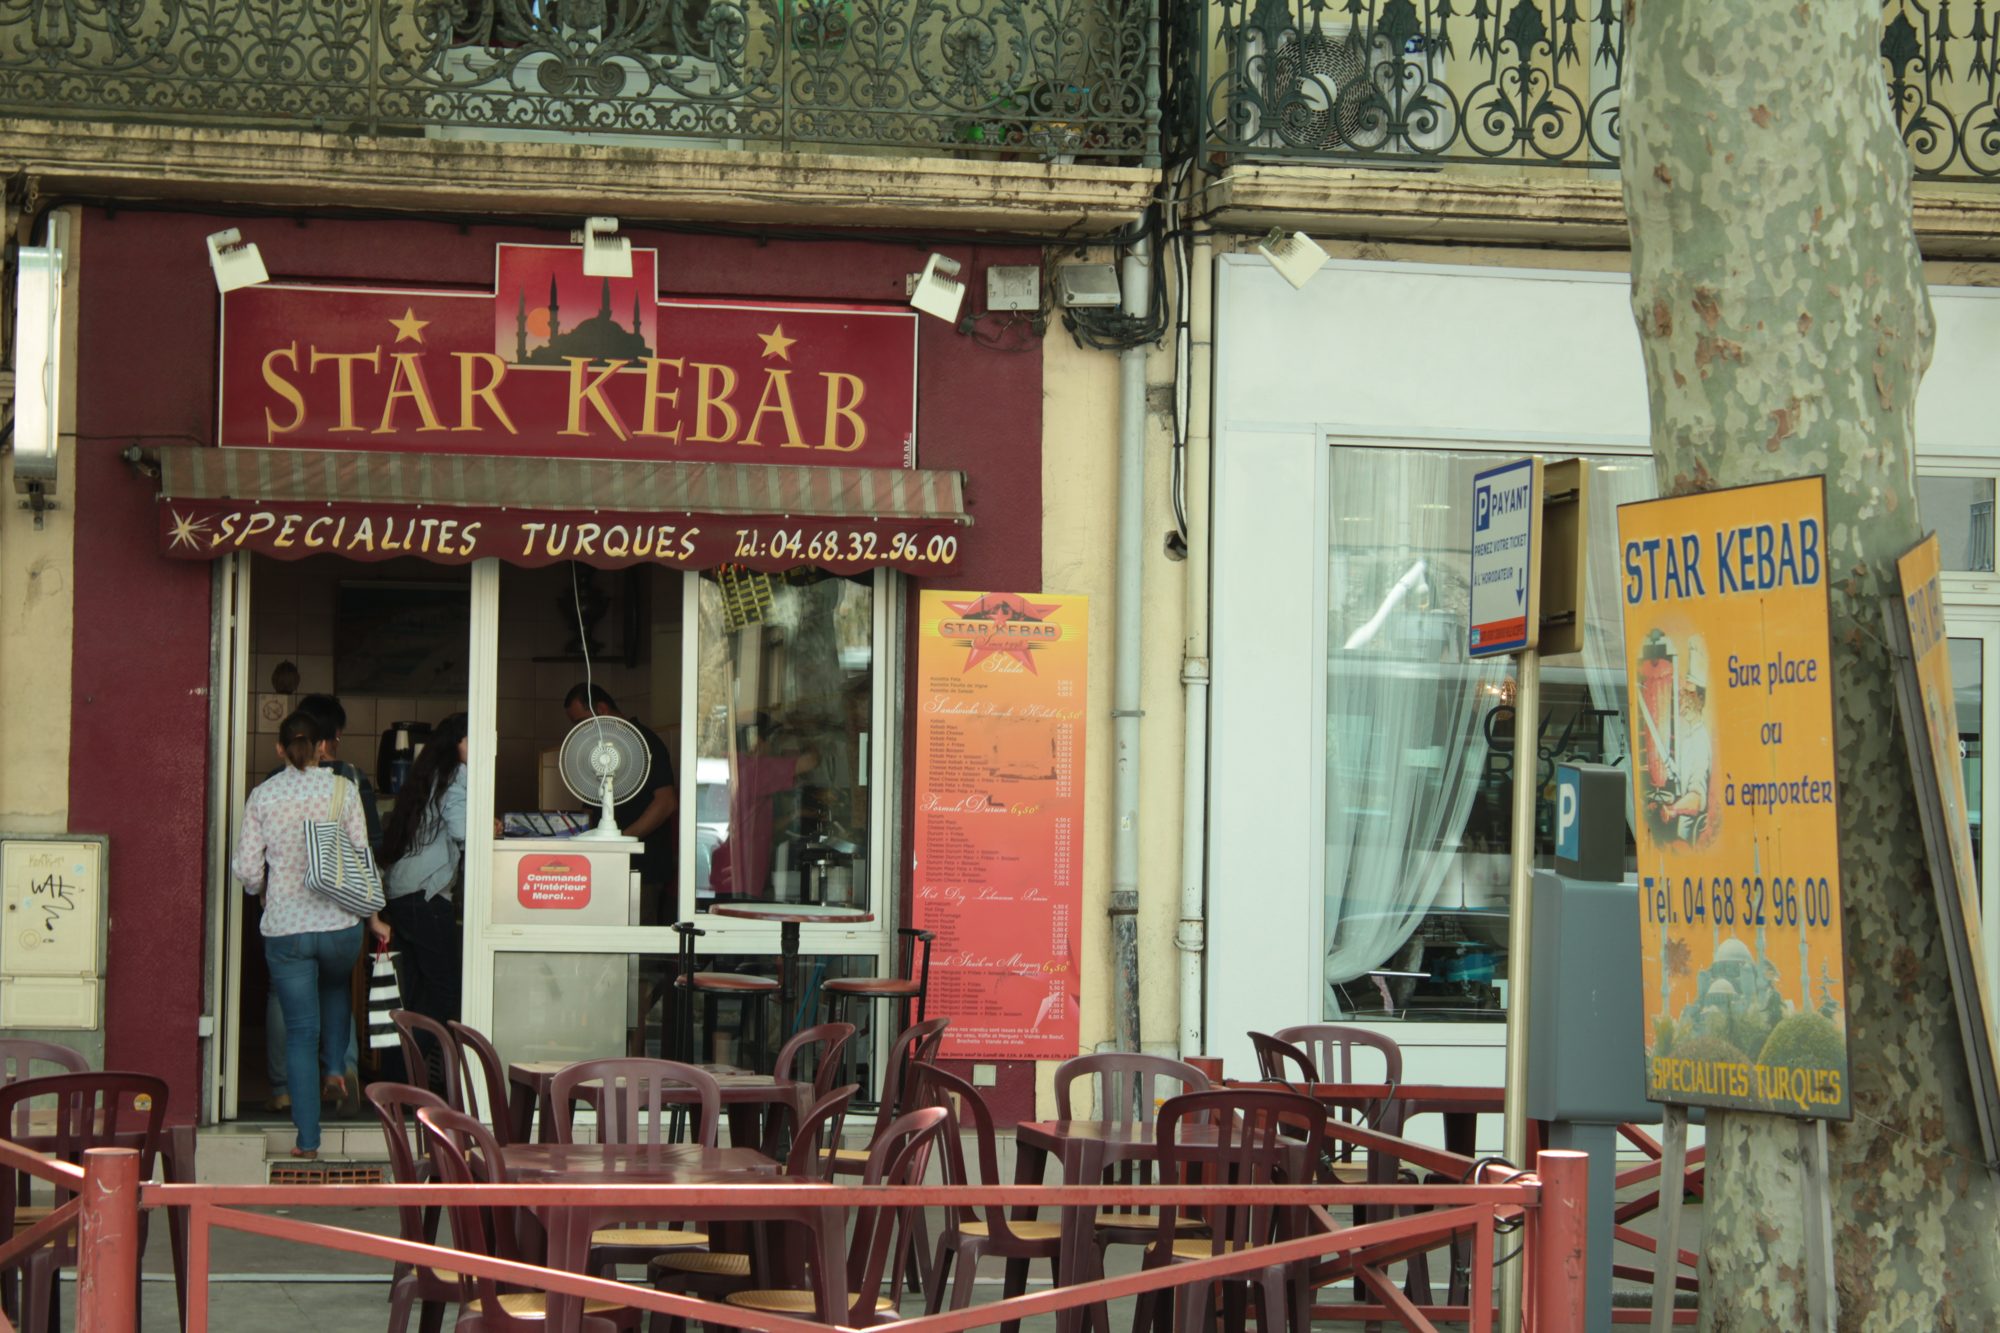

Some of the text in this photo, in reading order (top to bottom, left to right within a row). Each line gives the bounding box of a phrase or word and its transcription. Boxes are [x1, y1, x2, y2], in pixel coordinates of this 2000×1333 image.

[261, 340, 868, 454] STAR KEBAB
[1492, 485, 1529, 517] PAYANT
[212, 512, 482, 556] SPECIALITES
[522, 523, 700, 558] TURQUES
[1474, 532, 1527, 558] PRENEZ VOTRE TICKET
[1625, 517, 1822, 607] STAR KEBAB
[944, 623, 1055, 637] STAR KEBAB
[1727, 651, 1818, 696] Sur place
[1760, 722, 1782, 746] ou
[1558, 782, 1577, 846] P
[1724, 777, 1834, 816] à emporter
[523, 883, 587, 891] à l'intérieur
[527, 874, 587, 882] Commande
[1643, 876, 1831, 929] Tél. 04 68 32 96 00
[1652, 1056, 1842, 1111] SPECIALITES TURQUES
